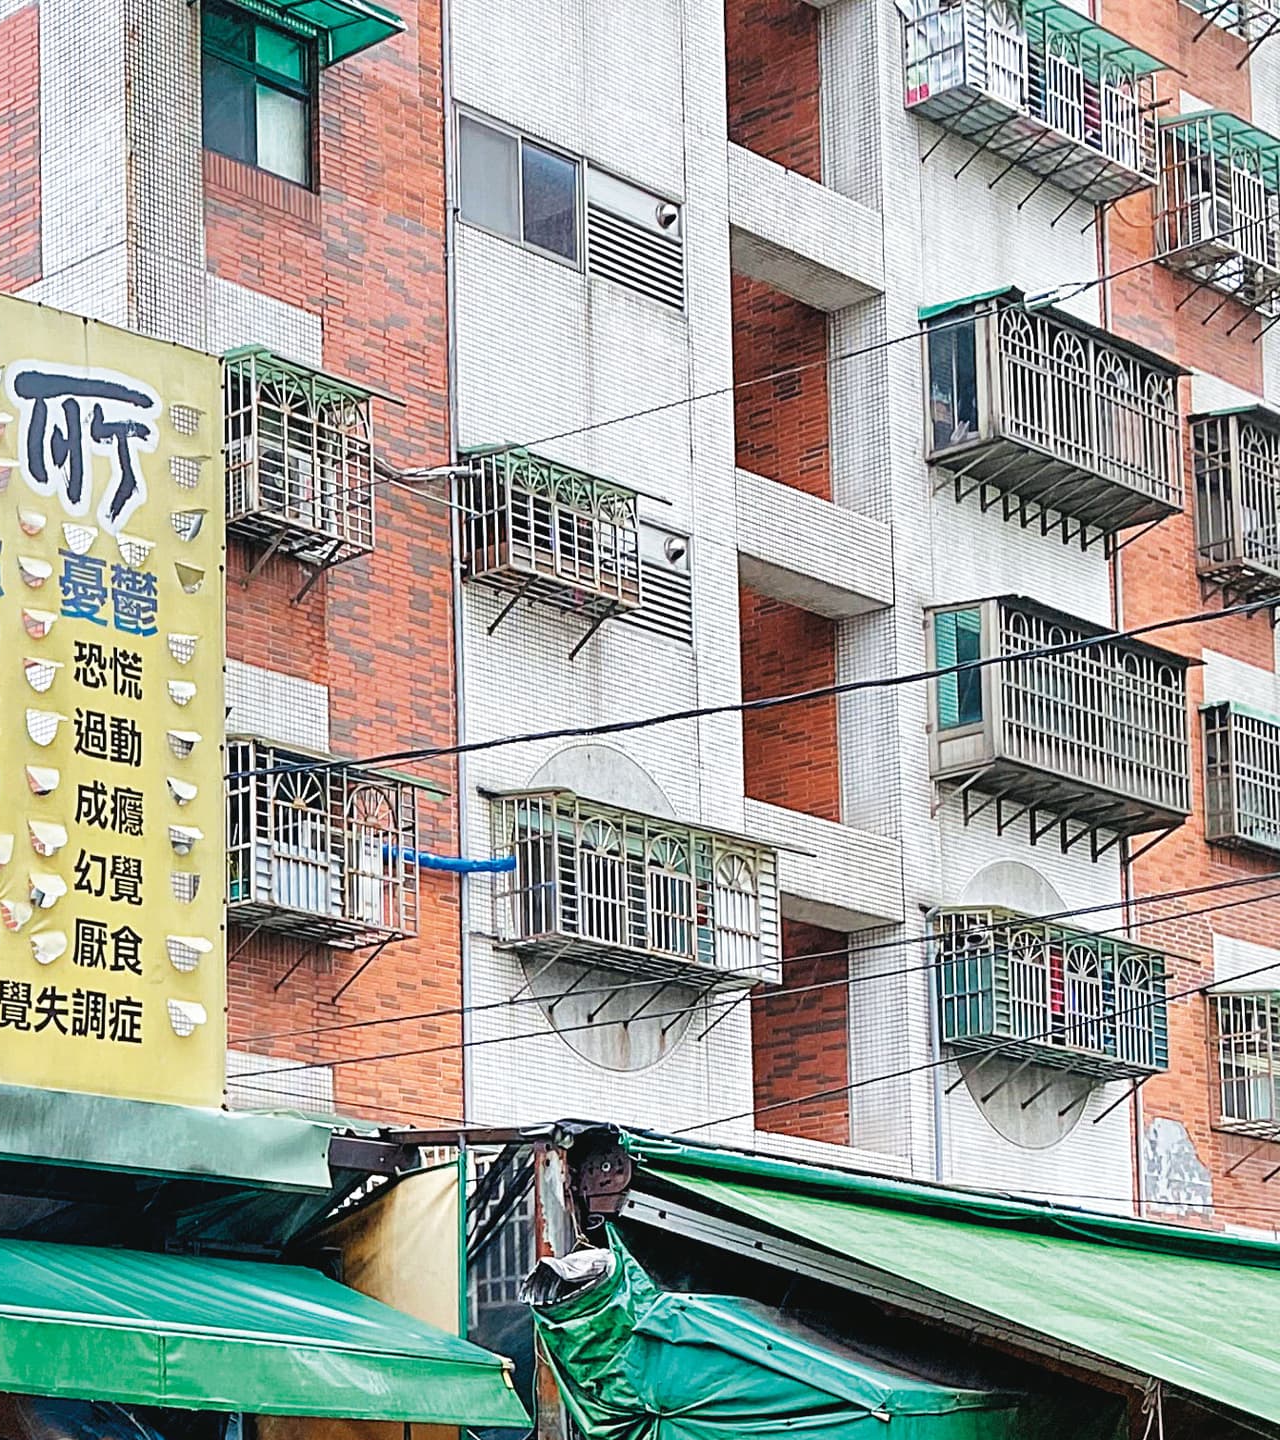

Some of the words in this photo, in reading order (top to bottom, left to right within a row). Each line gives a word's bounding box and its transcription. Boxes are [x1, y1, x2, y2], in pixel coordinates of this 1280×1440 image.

[59, 550, 158, 637] 憂鬱
[73, 640, 143, 700] 恐慌
[73, 708, 142, 768] 過動
[73, 780, 143, 837] 成癮
[73, 848, 142, 907] 幻覺
[73, 920, 143, 976] 厭食
